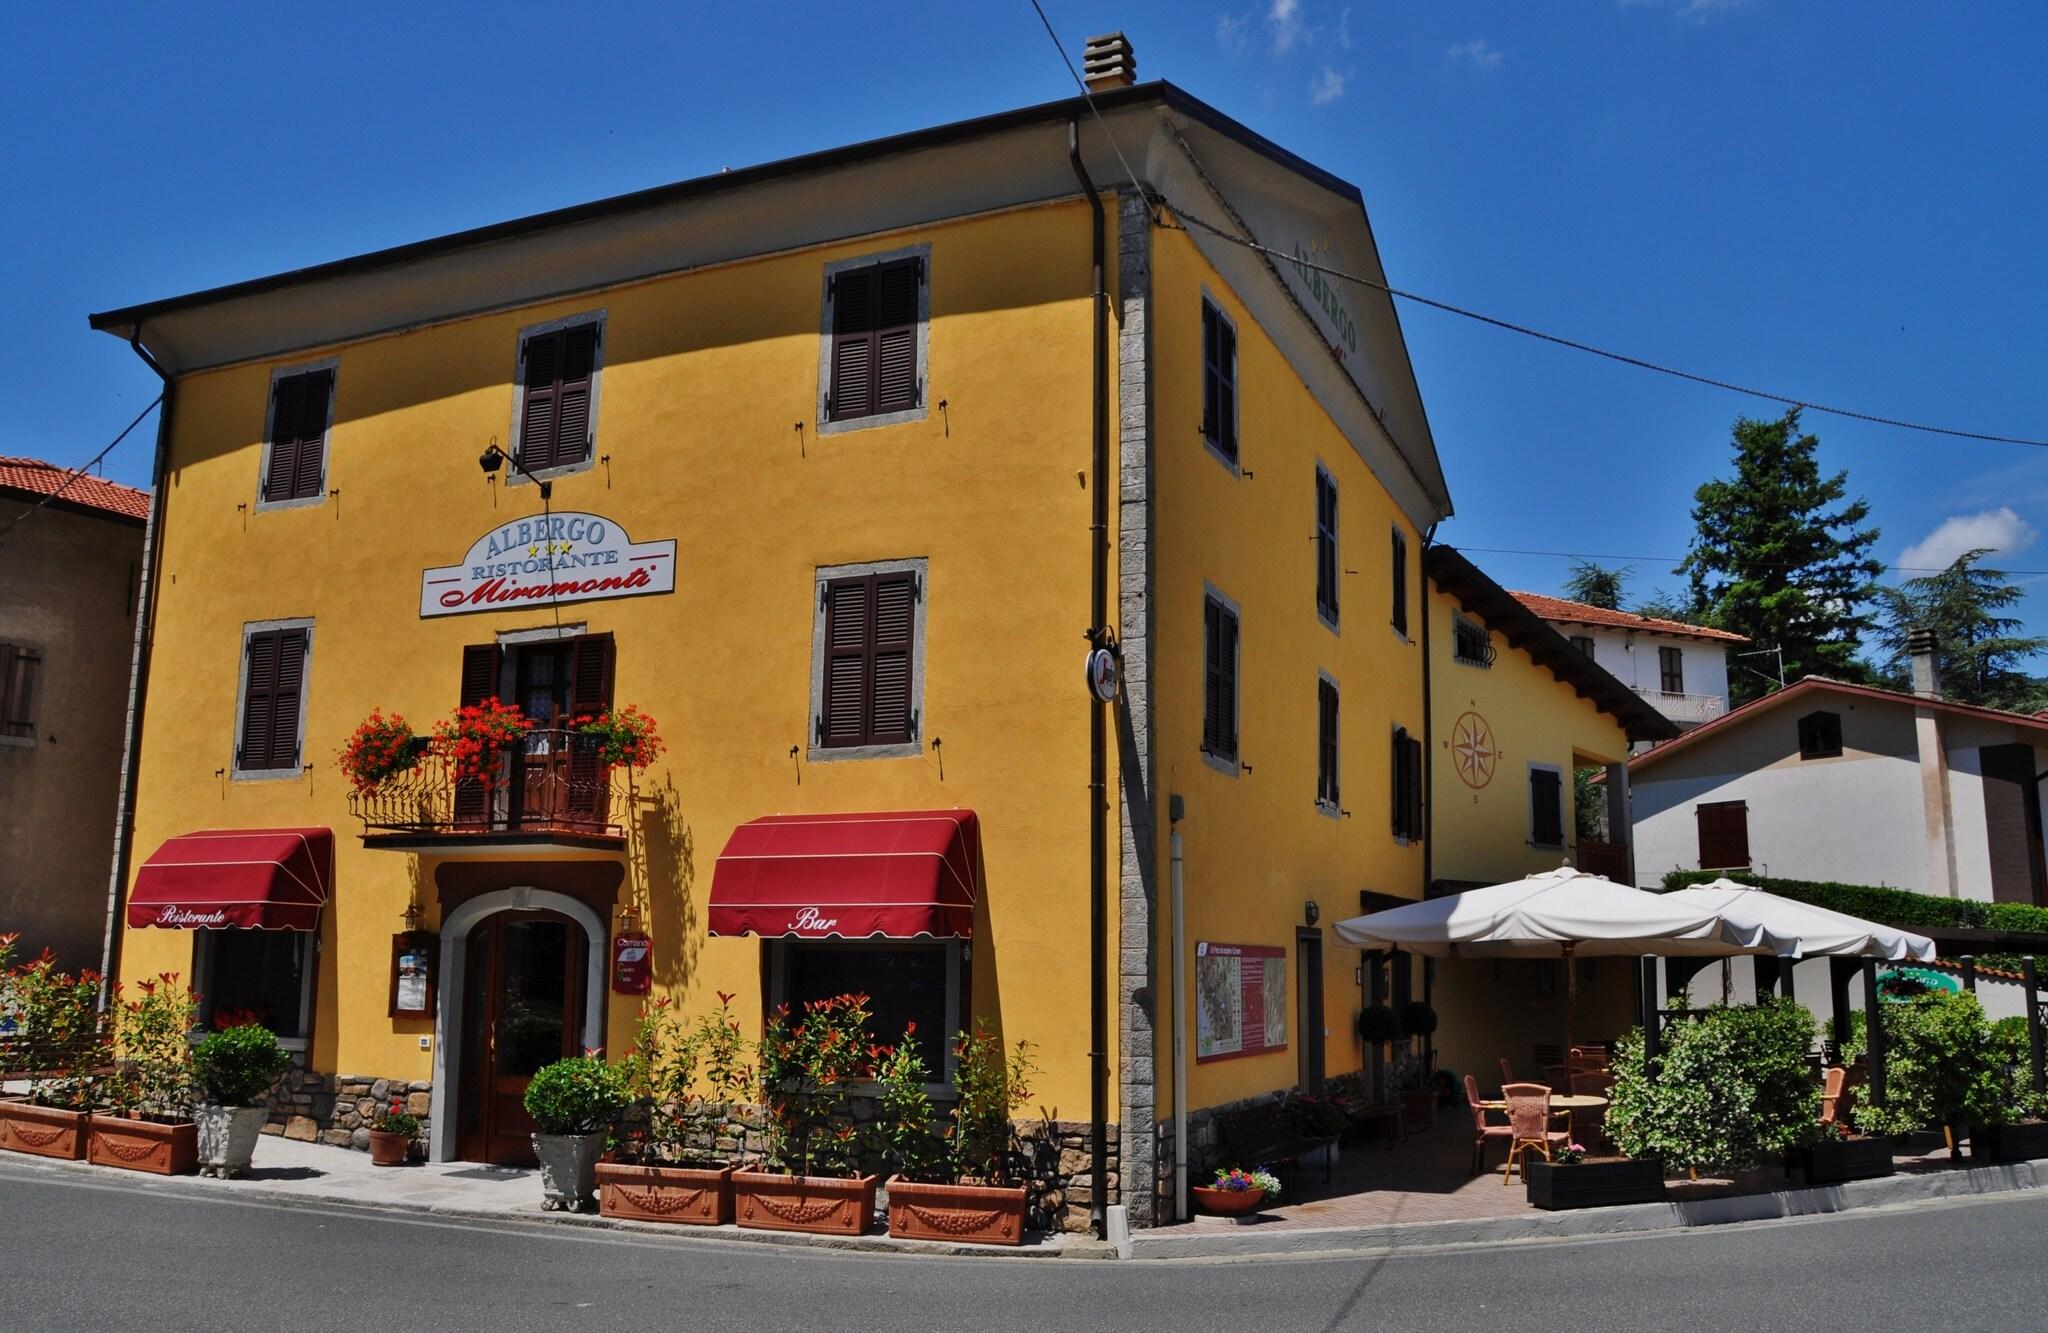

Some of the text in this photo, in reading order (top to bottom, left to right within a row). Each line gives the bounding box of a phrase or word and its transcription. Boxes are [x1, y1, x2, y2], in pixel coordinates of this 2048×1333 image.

[1293, 241, 1356, 352] ALBERGO
[486, 517, 605, 560] ALBERGO
[471, 550, 618, 580] RISTORANTE
[440, 565, 657, 607] Miramonti
[156, 905, 225, 924] Ristorante
[787, 907, 837, 930] Bar
